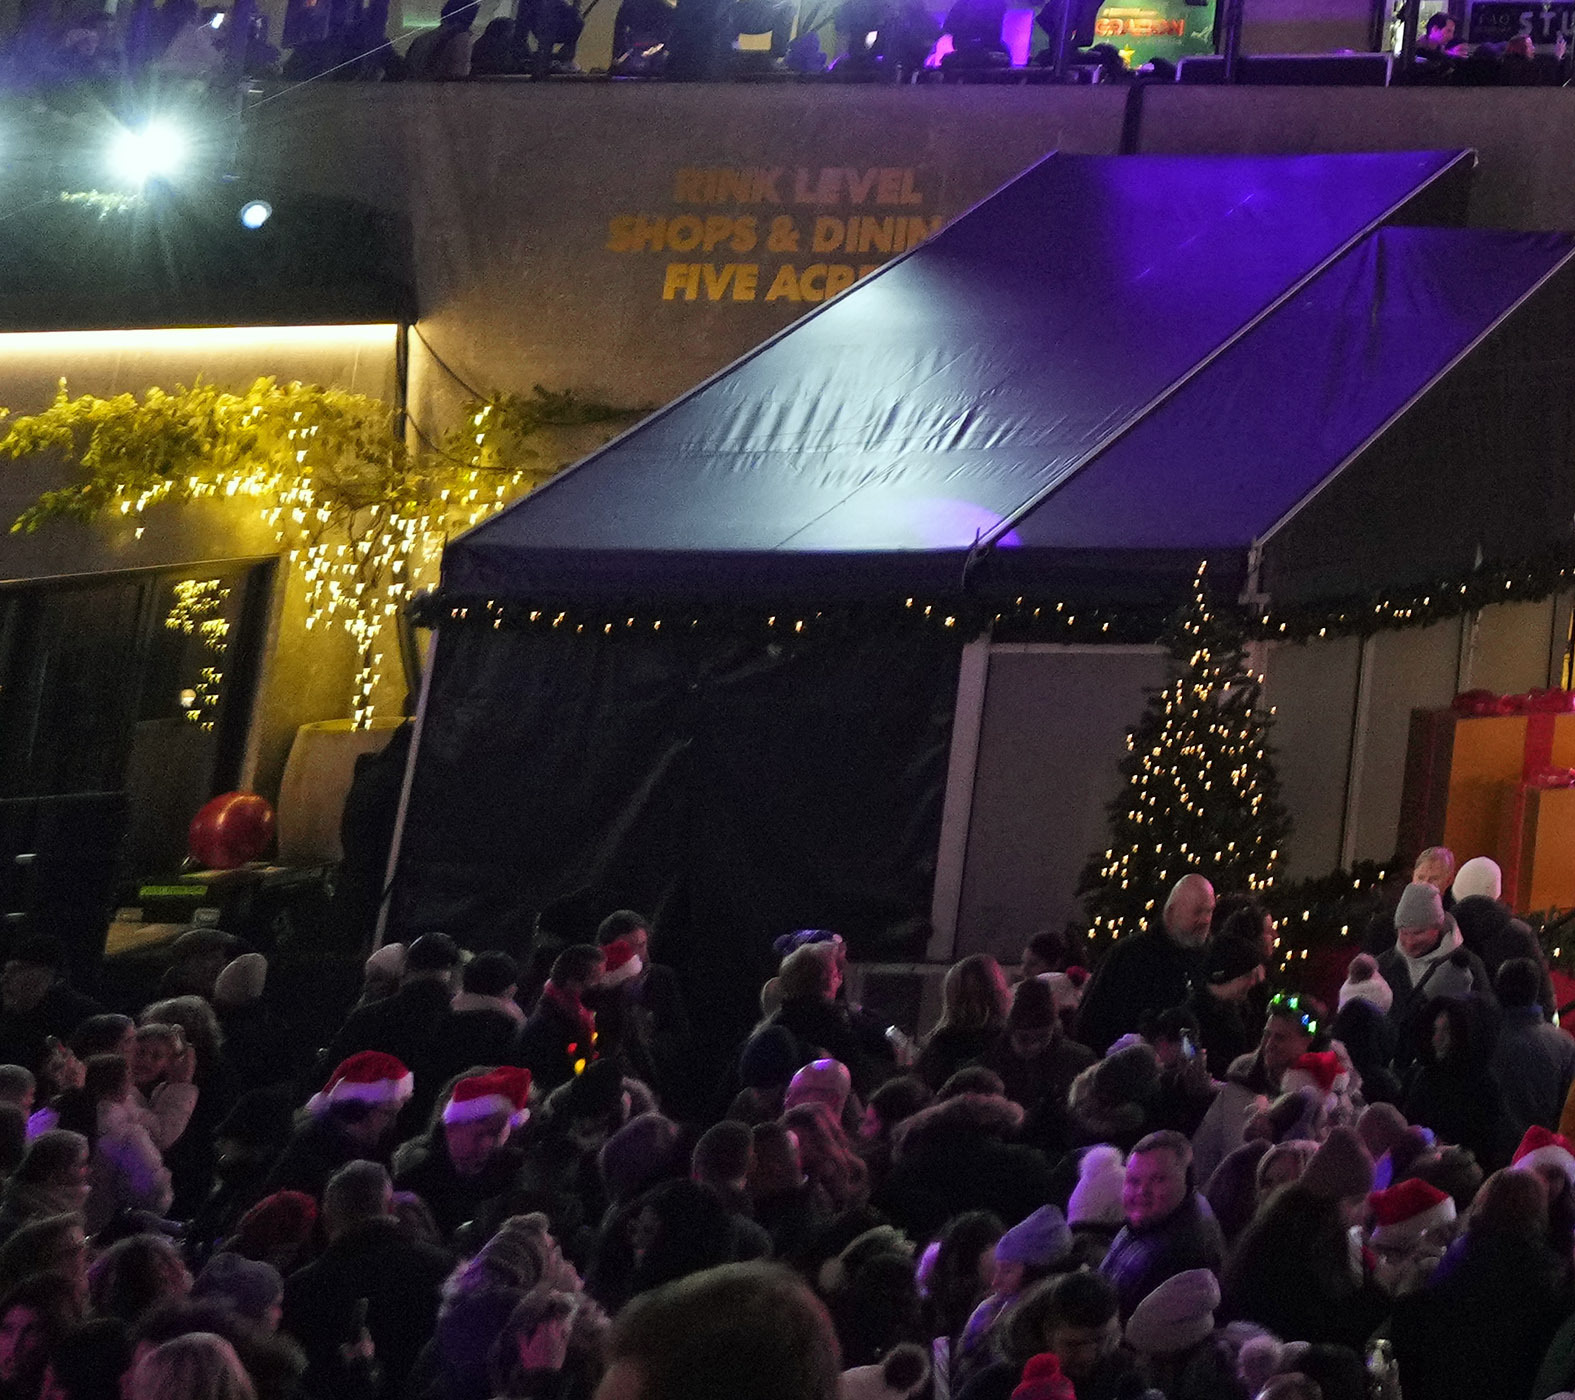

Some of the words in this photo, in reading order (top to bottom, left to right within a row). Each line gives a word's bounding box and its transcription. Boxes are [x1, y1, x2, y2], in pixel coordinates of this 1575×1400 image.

[673, 168, 784, 205] RINK
[795, 168, 925, 205] LEVEL
[605, 216, 759, 253] SHOPS
[767, 216, 801, 253] &
[812, 216, 944, 253] DININ
[661, 263, 760, 301] FIVE
[763, 263, 874, 301] ACR
